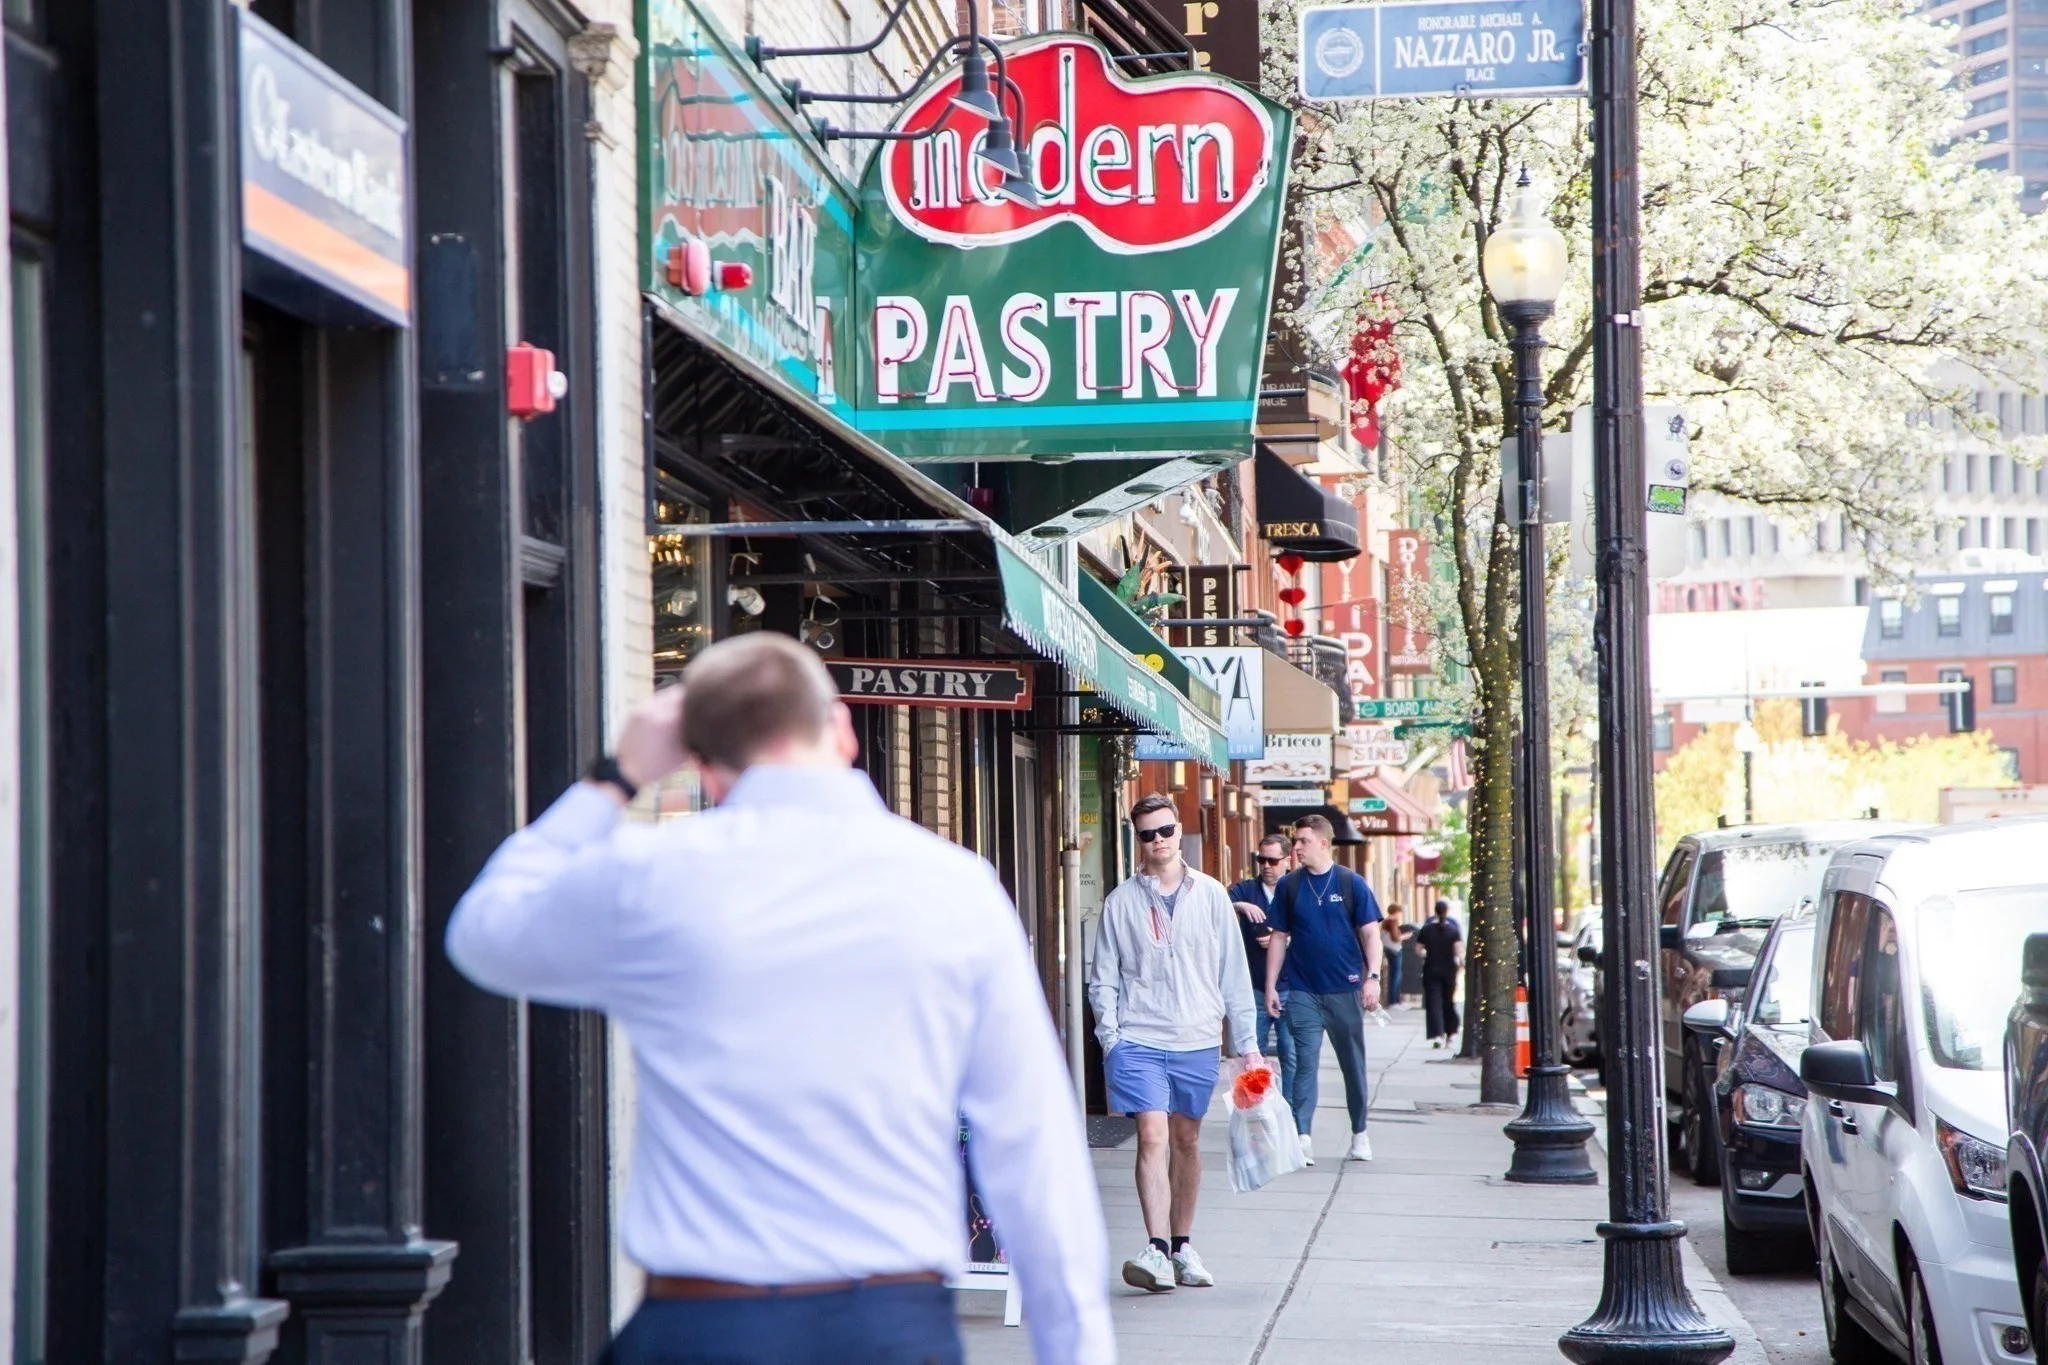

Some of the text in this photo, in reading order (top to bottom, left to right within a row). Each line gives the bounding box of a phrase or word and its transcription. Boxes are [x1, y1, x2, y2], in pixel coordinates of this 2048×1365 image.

[1419, 12, 1543, 31] HONORABLE MICHAEL A.
[1394, 29, 1565, 69] NAZZARO JR.
[1465, 67, 1496, 82] PLACE
[911, 47, 1234, 209] modern
[876, 287, 1240, 404] PASTRY
[1265, 522, 1320, 536] TRESCA
[849, 667, 993, 697] PASTRY
[1384, 702, 1419, 716] BOARD
[1264, 735, 1321, 748] Bricco
[1353, 746, 1405, 761] SINE
[1361, 815, 1388, 829] Vita
[968, 1263, 997, 1271] ELTZER
